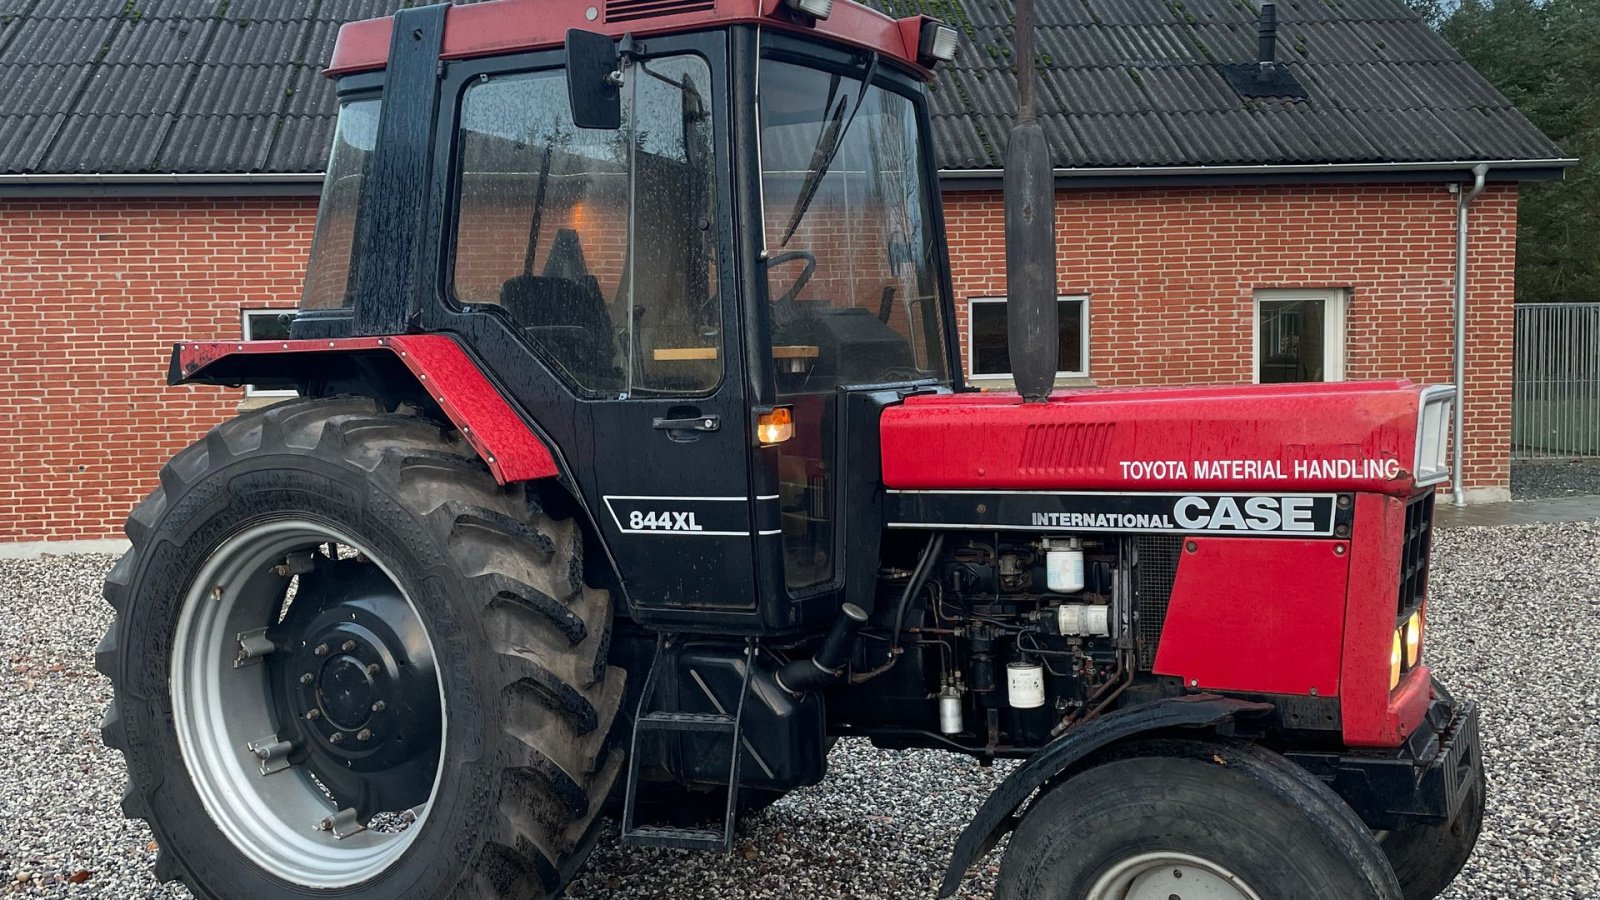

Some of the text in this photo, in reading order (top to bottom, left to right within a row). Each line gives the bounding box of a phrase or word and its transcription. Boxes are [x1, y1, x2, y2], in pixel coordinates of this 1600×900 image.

[1119, 458, 1400, 481] TOYOTA MATERIAL HANDLING
[629, 511, 703, 531] 844XL
[1031, 496, 1315, 531] INTERNATIONAL CASE
